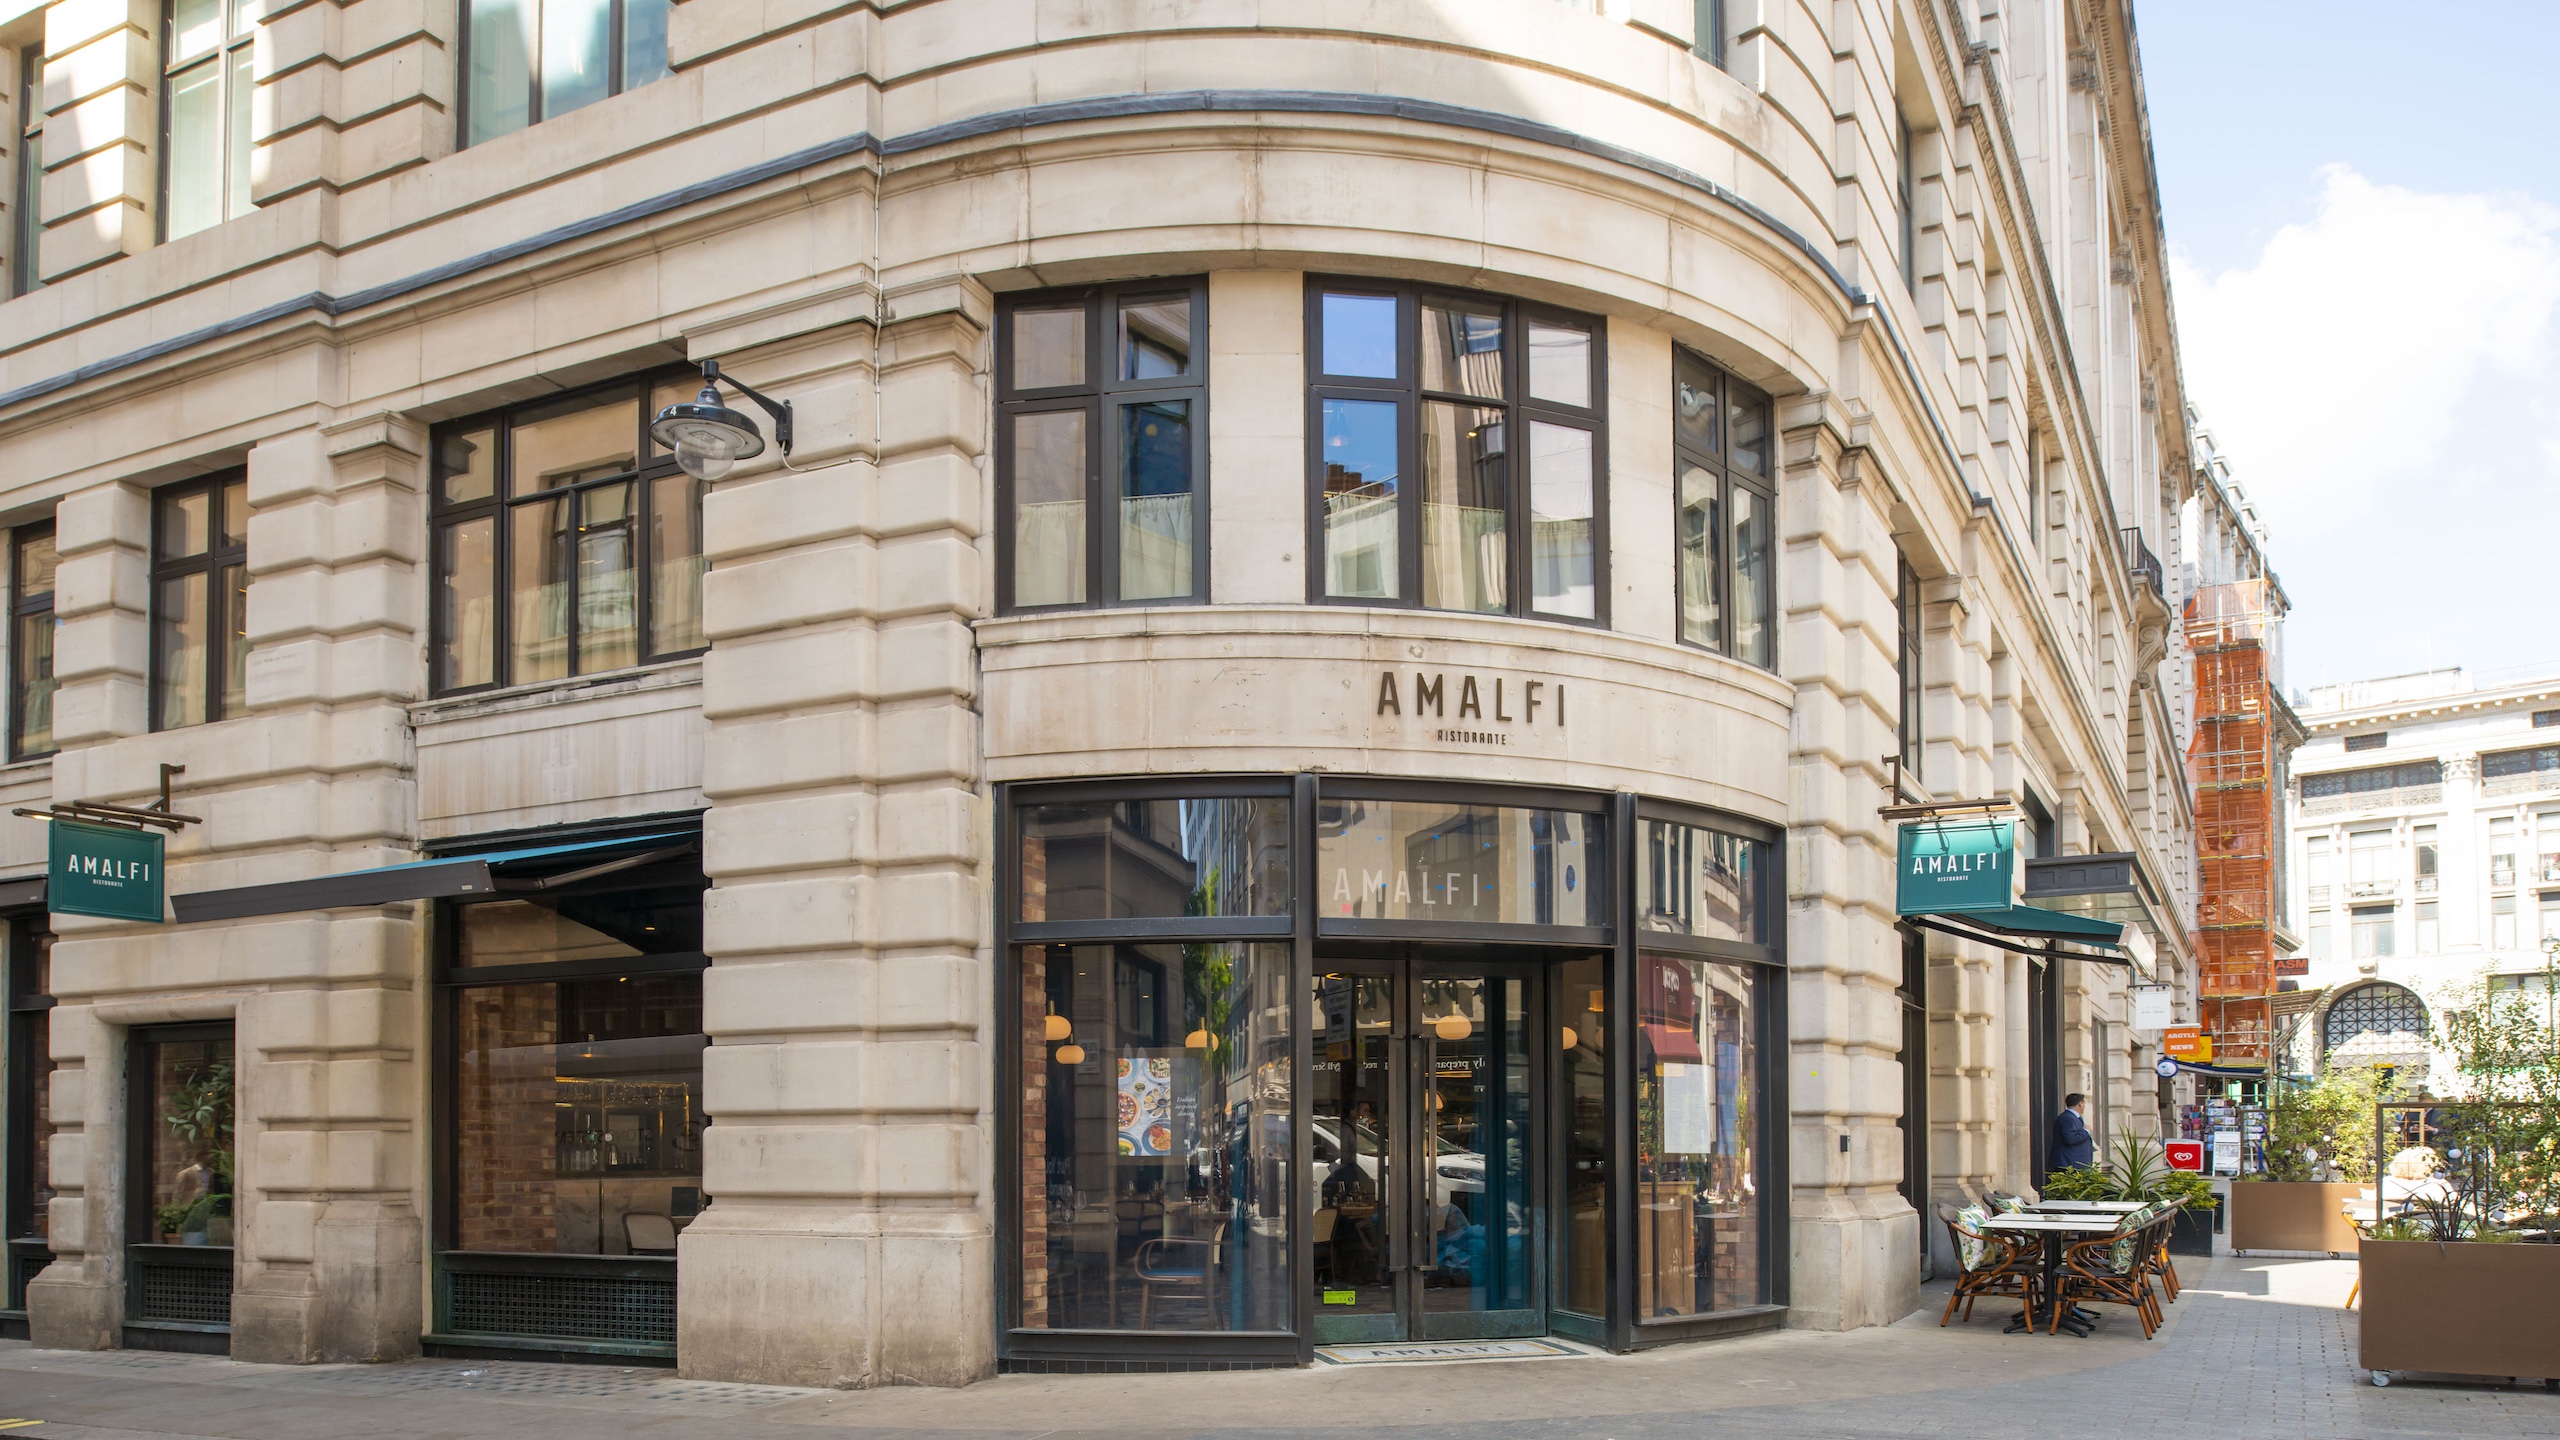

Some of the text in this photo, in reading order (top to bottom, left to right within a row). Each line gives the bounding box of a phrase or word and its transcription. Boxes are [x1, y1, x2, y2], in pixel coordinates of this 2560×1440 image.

[669, 405, 677, 416] 4
[1377, 671, 1564, 727] AMALFI
[1437, 729, 1506, 746] RISTORANTE
[68, 854, 149, 882] AMALFI
[1912, 852, 1996, 875] AMALFI
[1333, 867, 1478, 907] AMALFI
[1371, 1346, 1511, 1357] AMALFI
